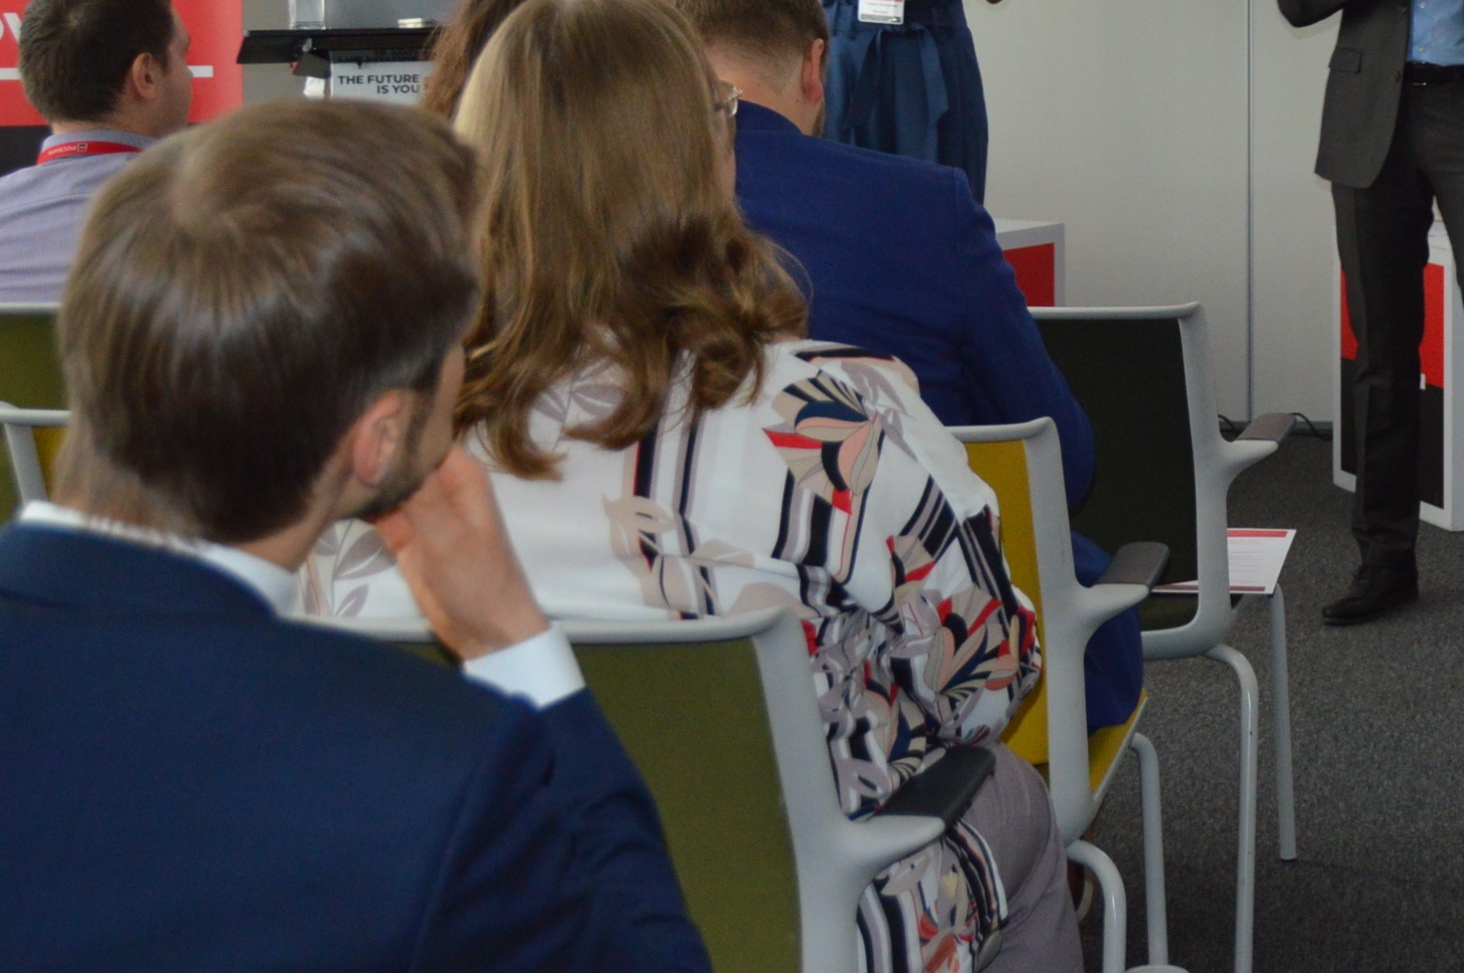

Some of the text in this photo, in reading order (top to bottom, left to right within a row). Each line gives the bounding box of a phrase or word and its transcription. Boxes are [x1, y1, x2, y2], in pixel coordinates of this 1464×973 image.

[338, 73, 419, 84] THE FUTURE
[376, 84, 420, 94] IS YOU
